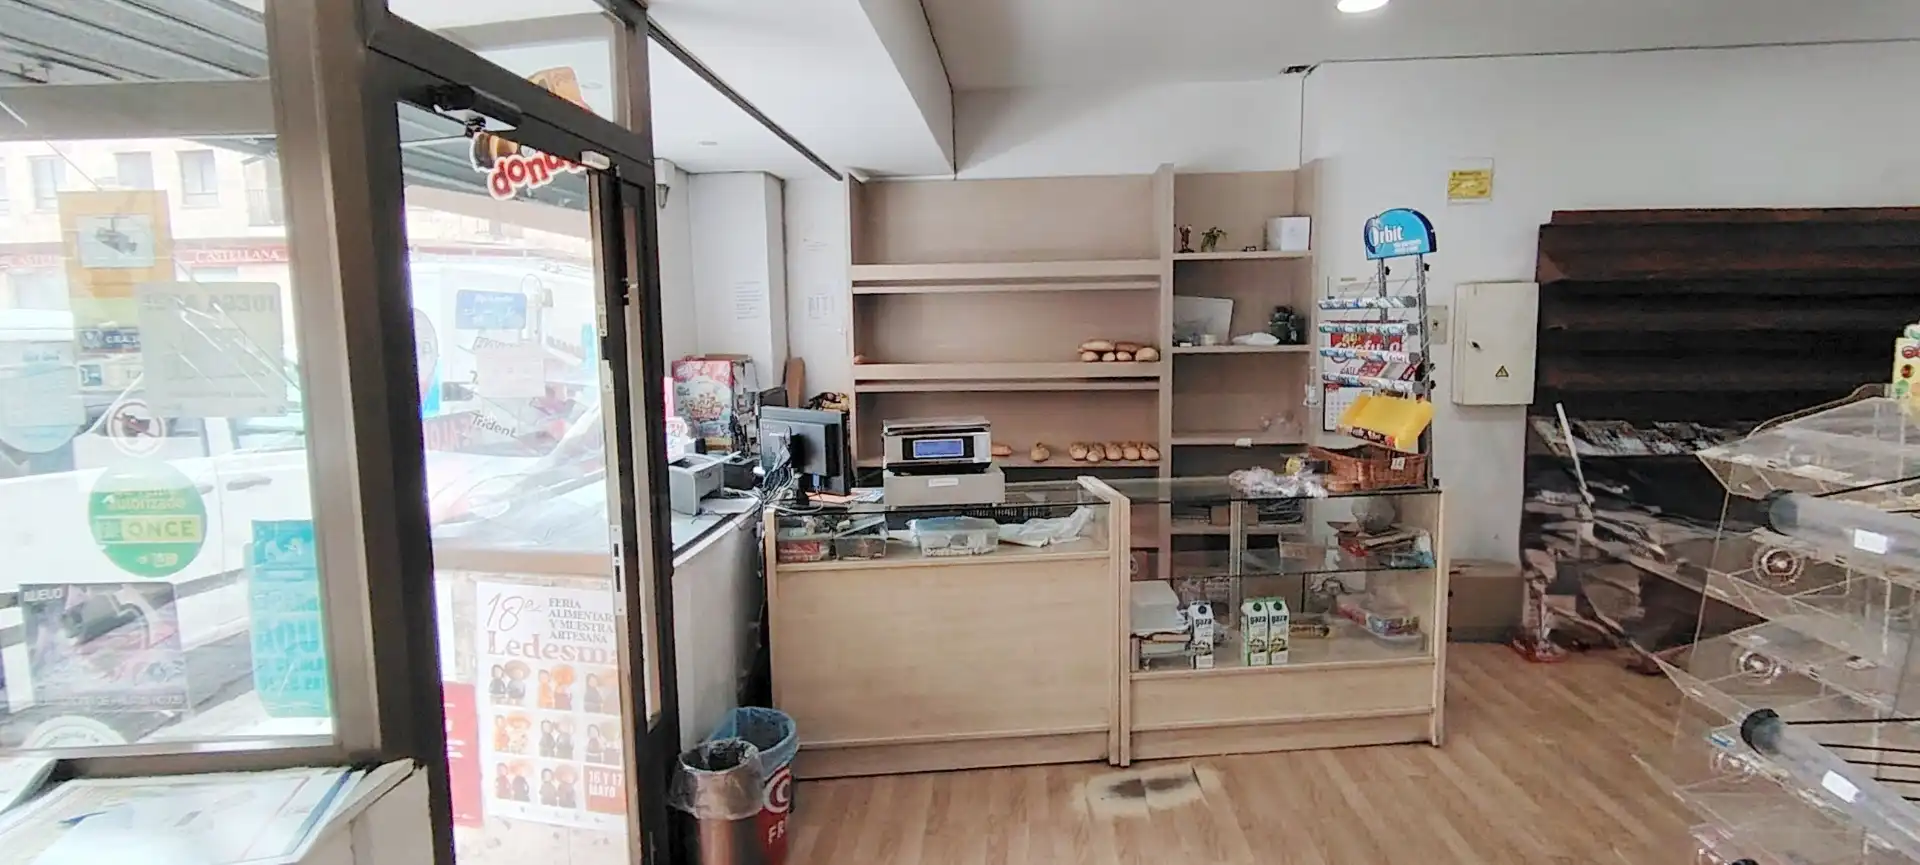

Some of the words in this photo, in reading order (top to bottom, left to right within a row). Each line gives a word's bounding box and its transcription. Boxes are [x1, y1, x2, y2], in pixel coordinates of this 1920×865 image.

[1368, 223, 1404, 247] Orbit
[195, 249, 280, 263] CASTELLANA
[469, 411, 519, 439] Trident
[128, 520, 195, 537] ONCE
[548, 597, 581, 609] FERIA
[548, 618, 559, 629] Y
[560, 619, 614, 634] MUESTRA
[1195, 618, 1213, 628] gaza
[1250, 615, 1267, 625] gaza
[1271, 615, 1288, 624] gaza
[548, 630, 608, 644] ARTESANA
